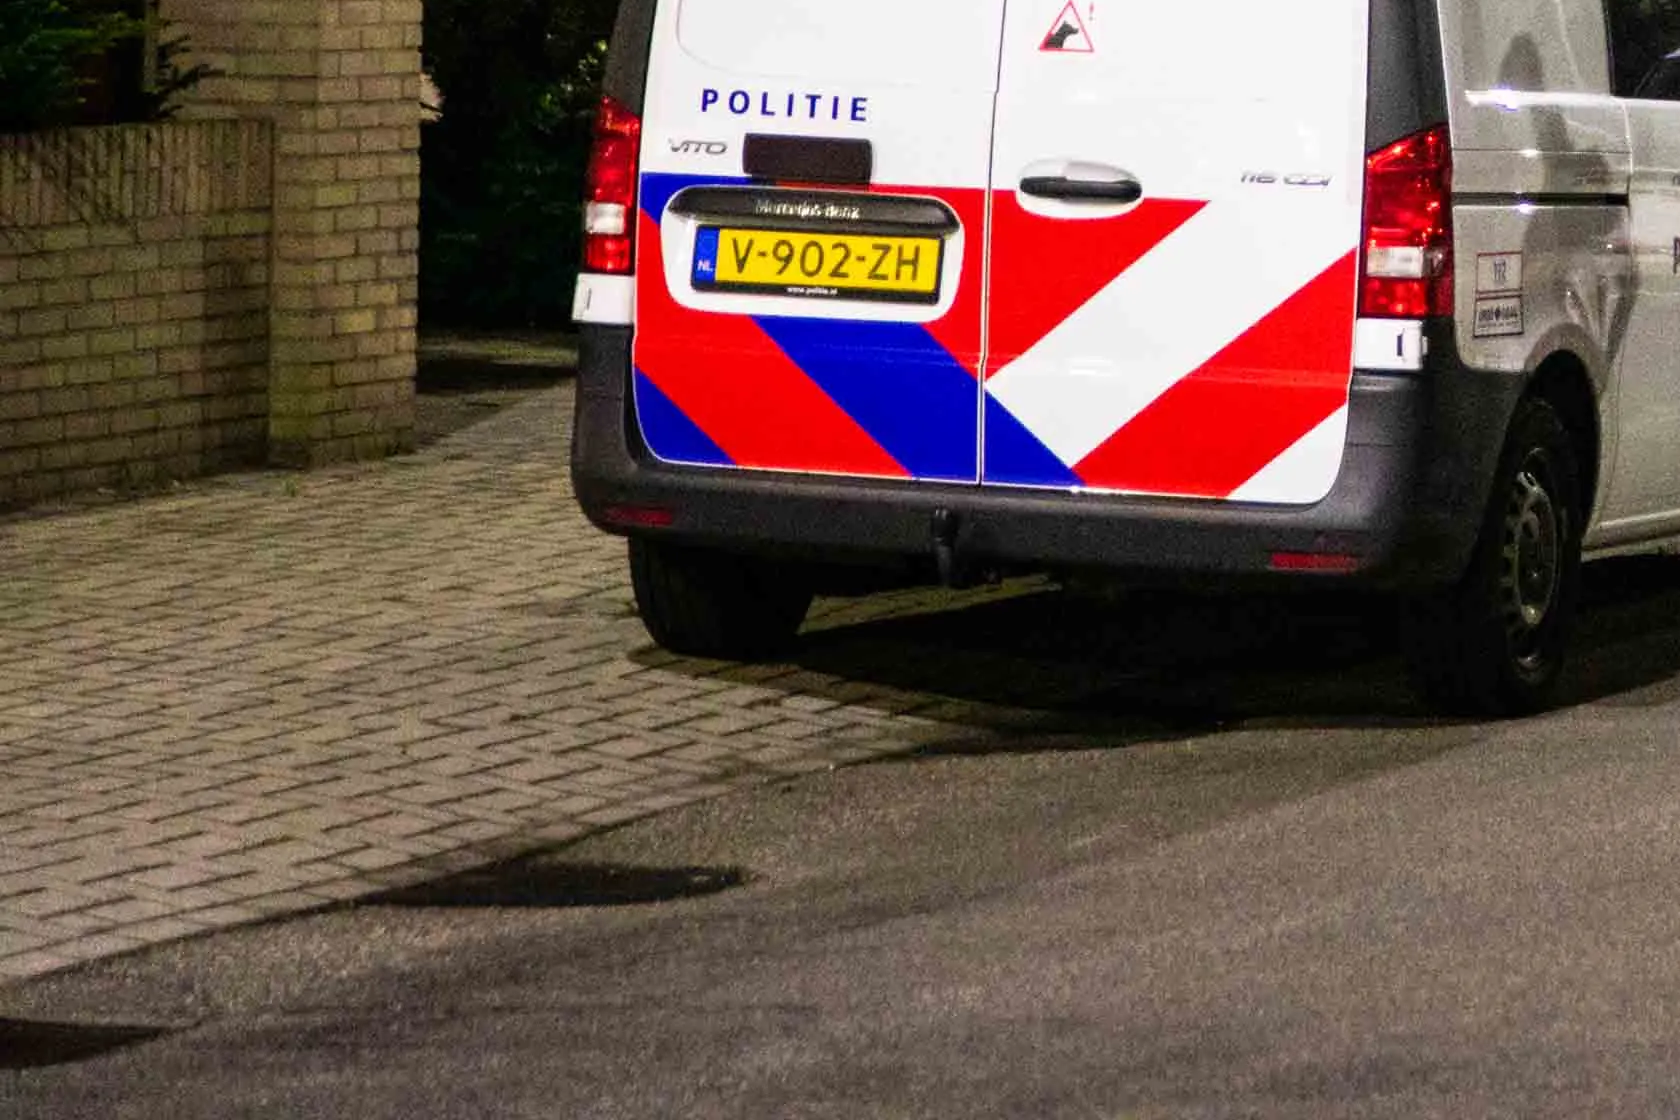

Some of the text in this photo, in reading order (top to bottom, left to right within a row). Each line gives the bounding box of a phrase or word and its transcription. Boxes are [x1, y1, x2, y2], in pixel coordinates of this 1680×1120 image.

[700, 88, 868, 122] POLITIE
[667, 137, 728, 155] VITO
[697, 259, 714, 272] NL
[732, 237, 920, 281] V-902-ZH
